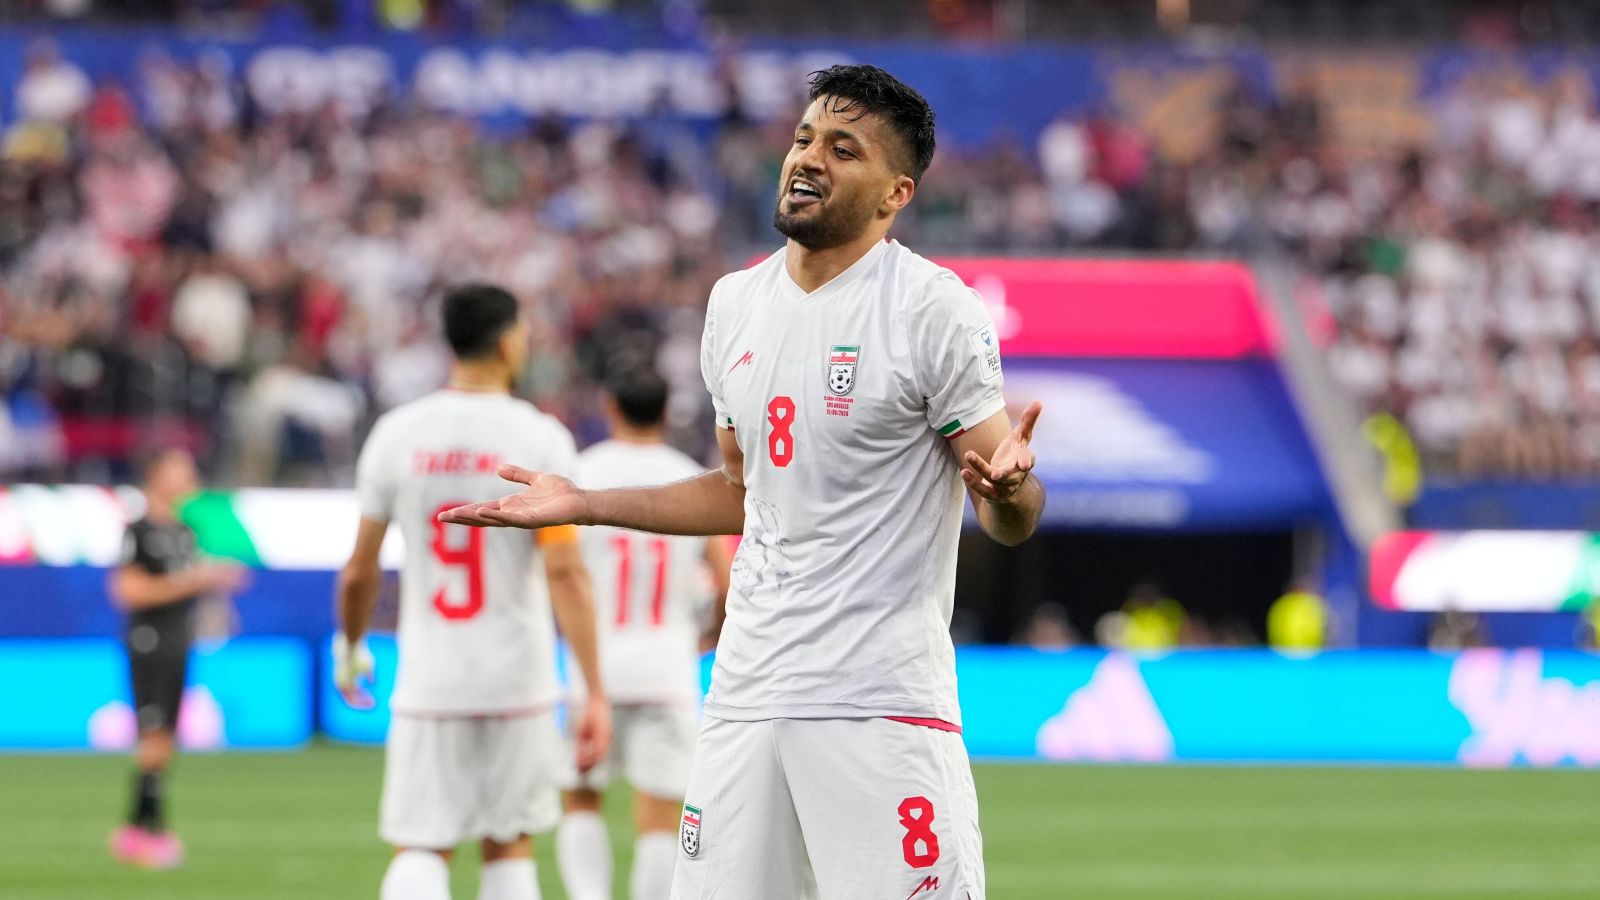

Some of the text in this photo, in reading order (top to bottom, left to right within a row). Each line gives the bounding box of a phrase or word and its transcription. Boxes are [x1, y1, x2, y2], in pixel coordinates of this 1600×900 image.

[768, 396, 795, 467] 8
[432, 502, 485, 620] 9
[607, 536, 668, 627] 11
[898, 796, 940, 868] 8
